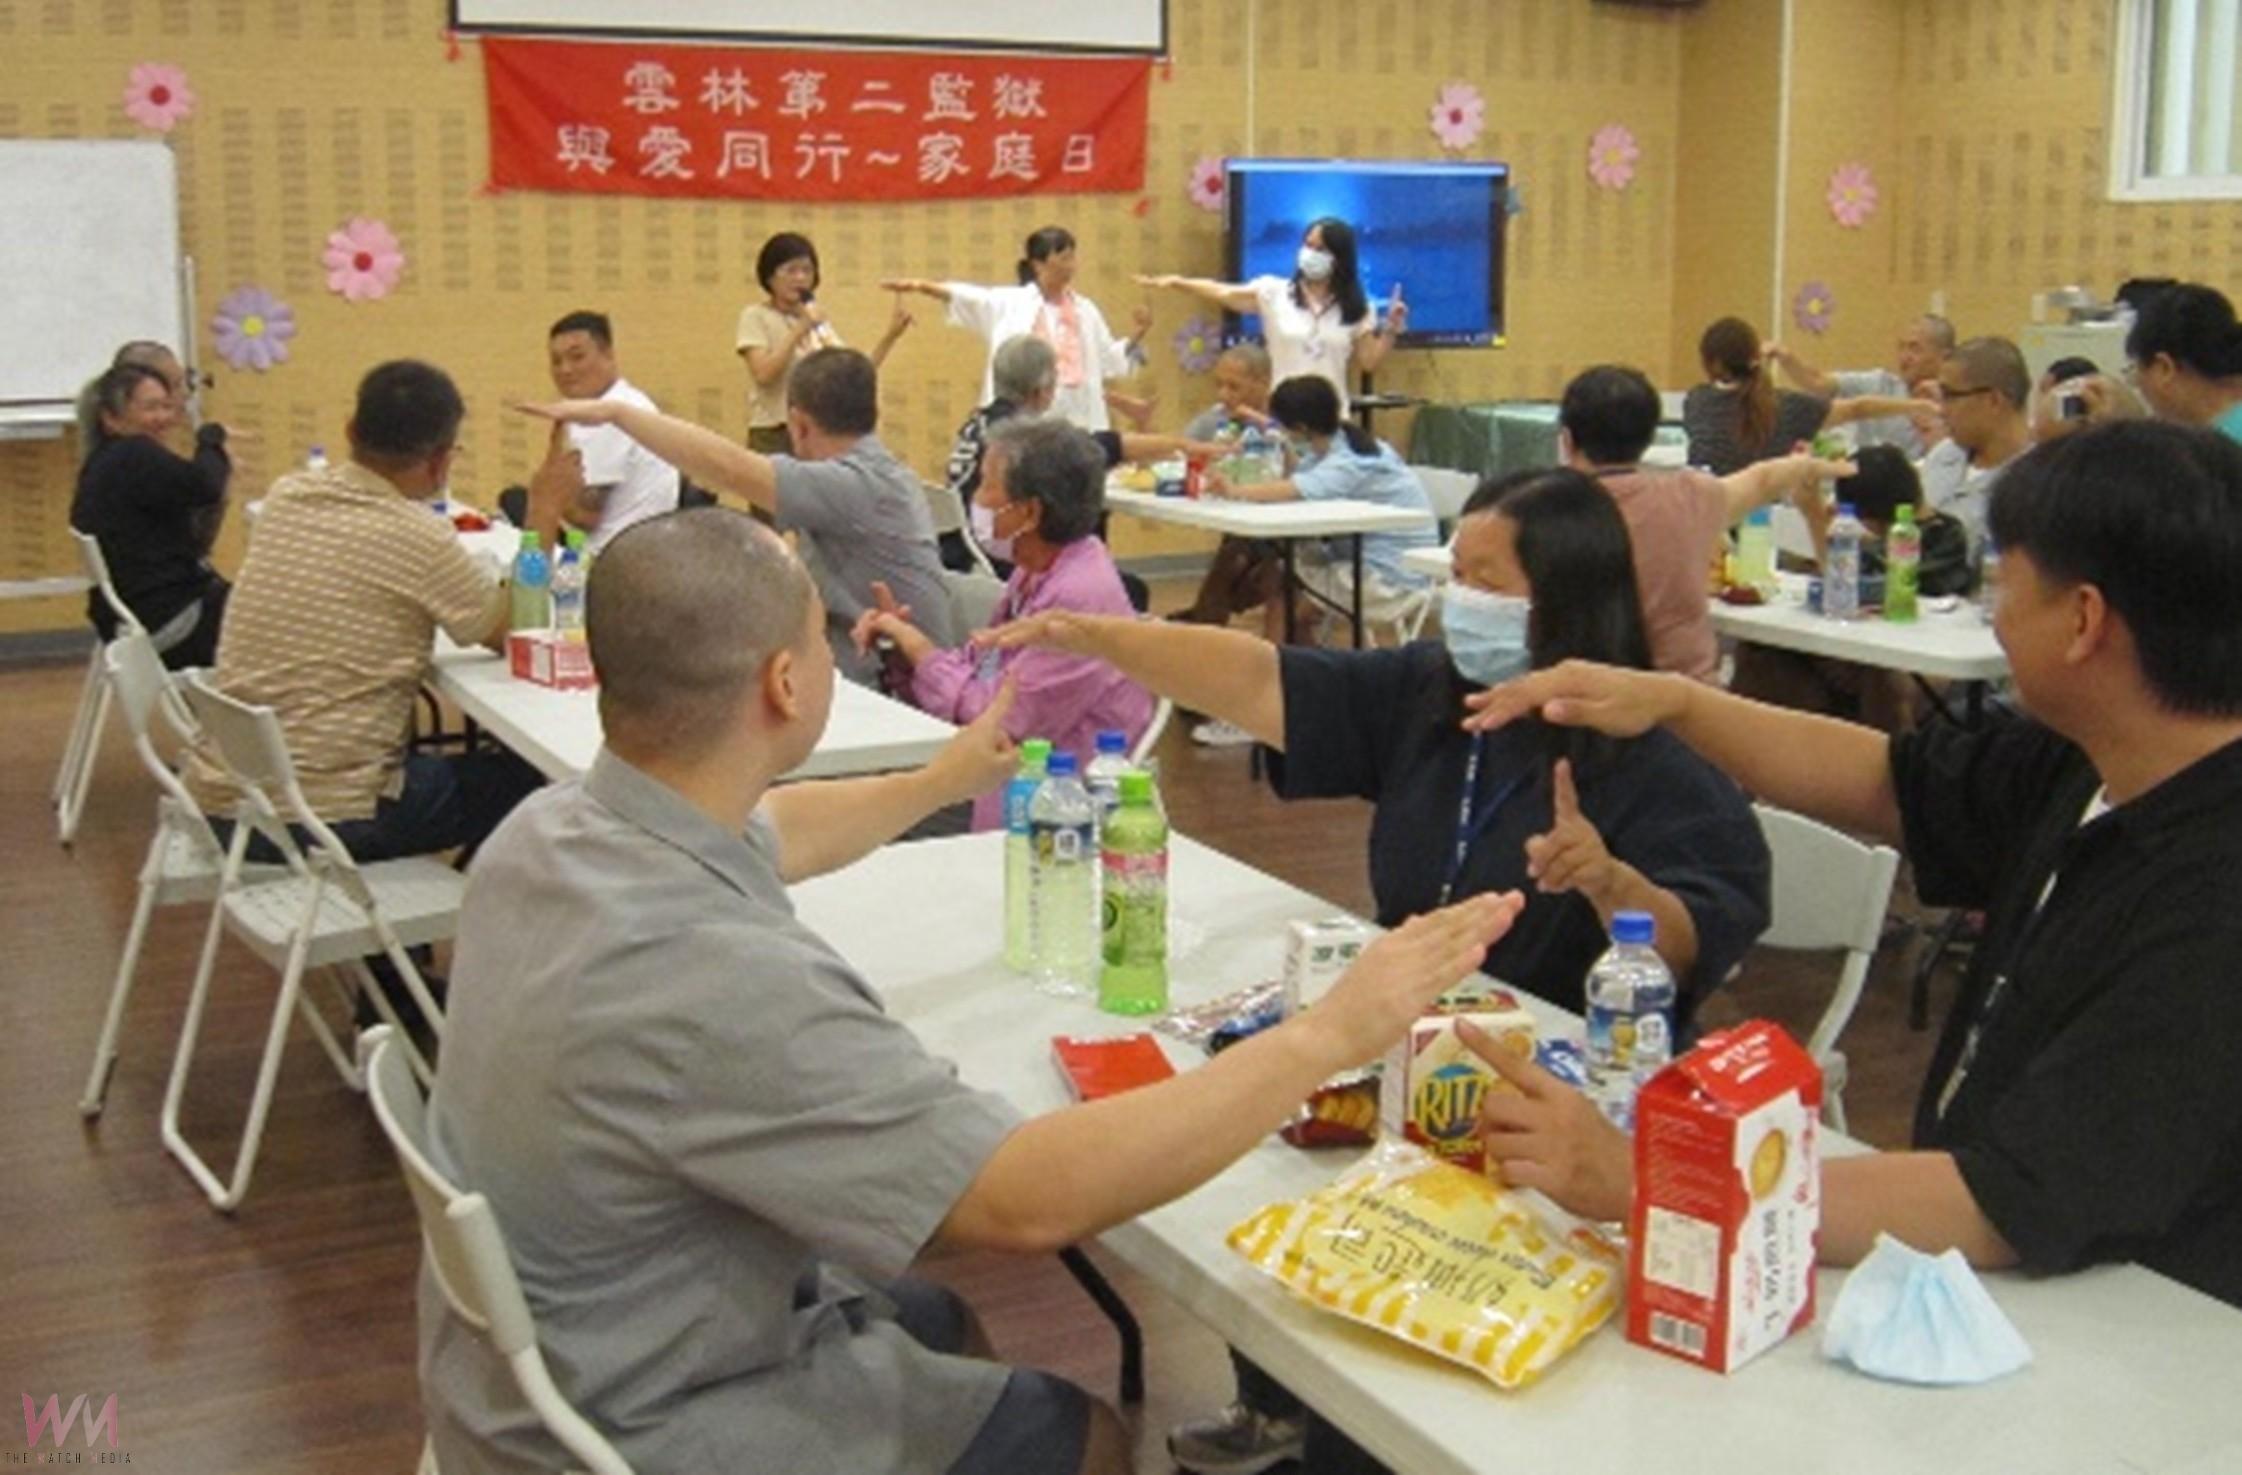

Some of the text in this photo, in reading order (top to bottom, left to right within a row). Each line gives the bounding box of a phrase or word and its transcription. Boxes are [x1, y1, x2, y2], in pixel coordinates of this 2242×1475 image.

[622, 60, 1047, 122] 雲林第二監獄
